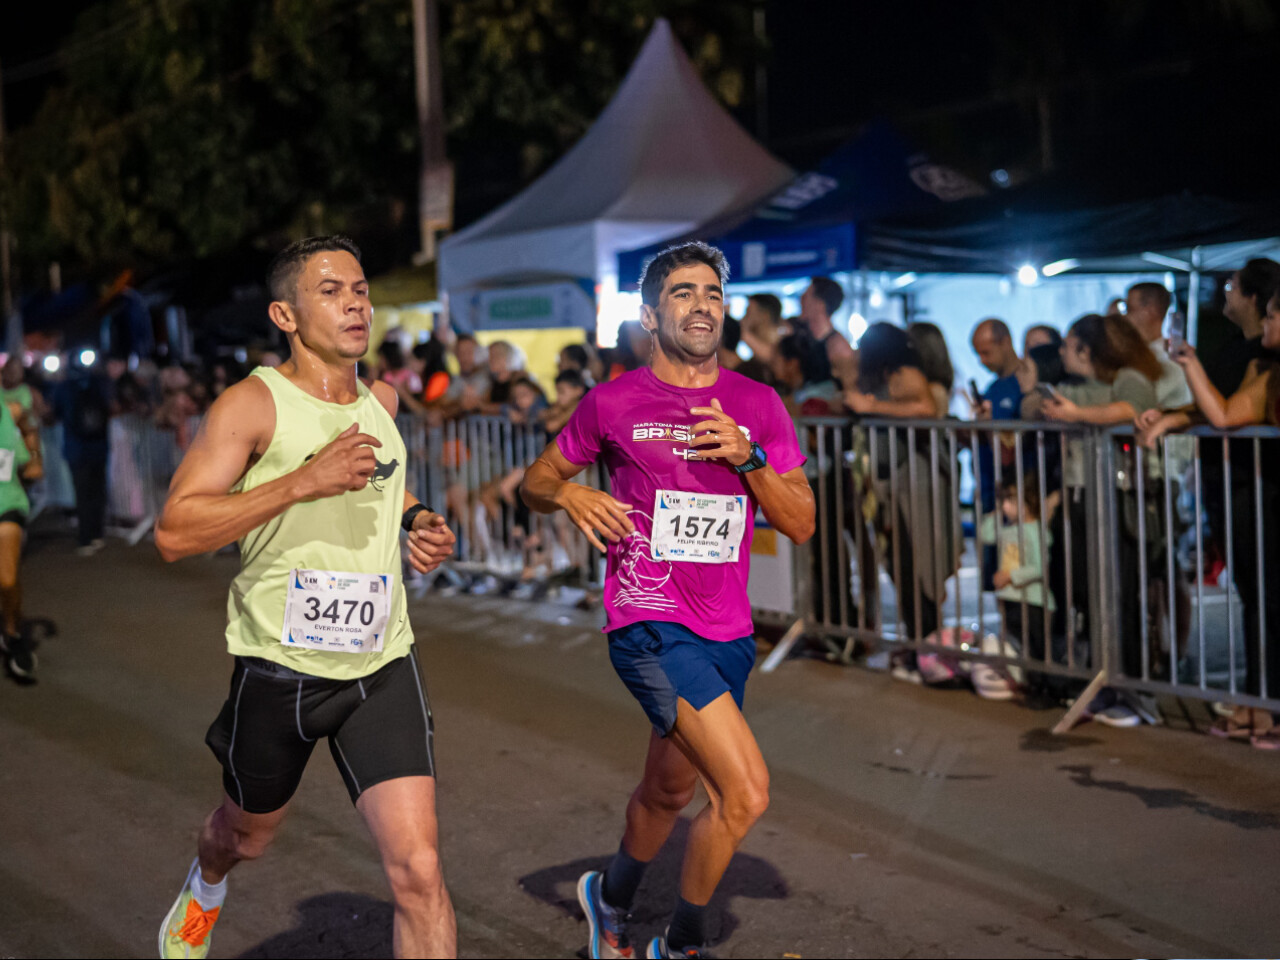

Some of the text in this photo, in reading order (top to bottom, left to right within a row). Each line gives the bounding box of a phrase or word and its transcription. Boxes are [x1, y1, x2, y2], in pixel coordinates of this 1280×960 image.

[670, 515, 730, 540] 1574
[303, 597, 374, 626] 3470
[314, 624, 344, 633] EVERTON
